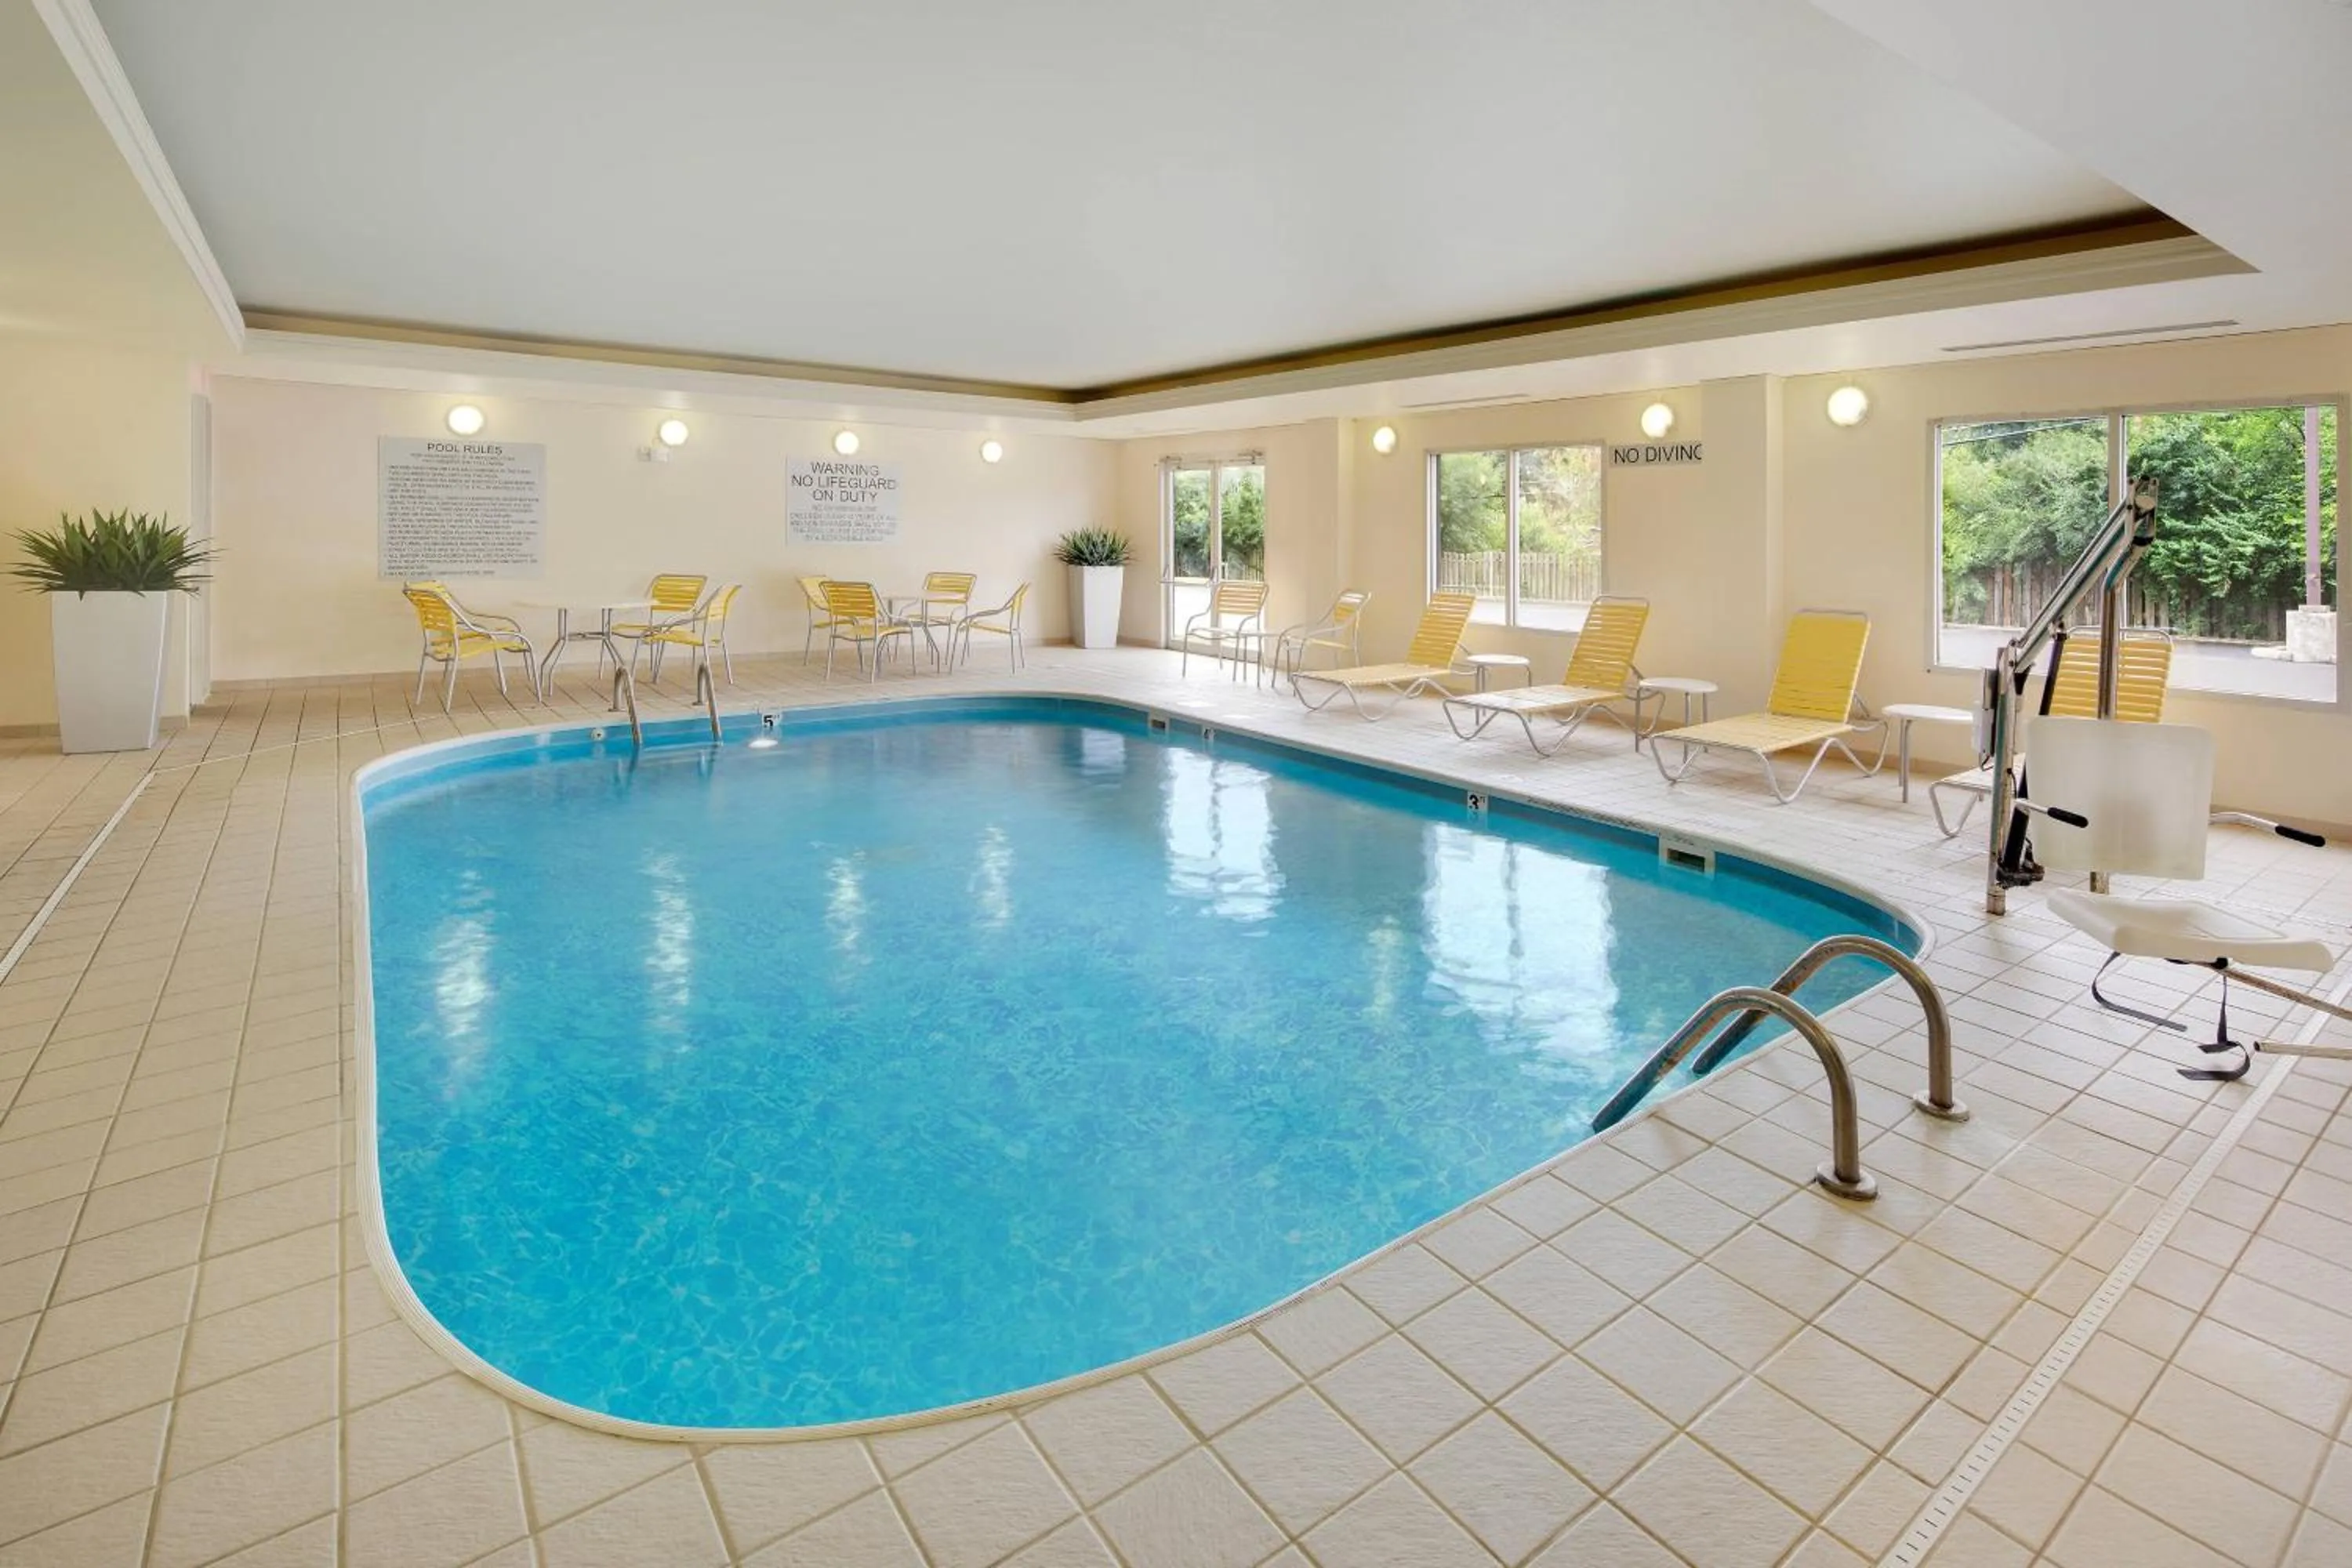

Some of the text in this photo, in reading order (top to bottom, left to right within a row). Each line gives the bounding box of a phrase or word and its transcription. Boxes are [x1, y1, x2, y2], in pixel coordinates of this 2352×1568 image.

[427, 443, 503, 455] POOL RULES
[1613, 448, 1639, 464] NO
[811, 462, 880, 477] WARNING
[791, 474, 896, 490] NO LIFEGUARD
[812, 489, 879, 503] ON DUTY
